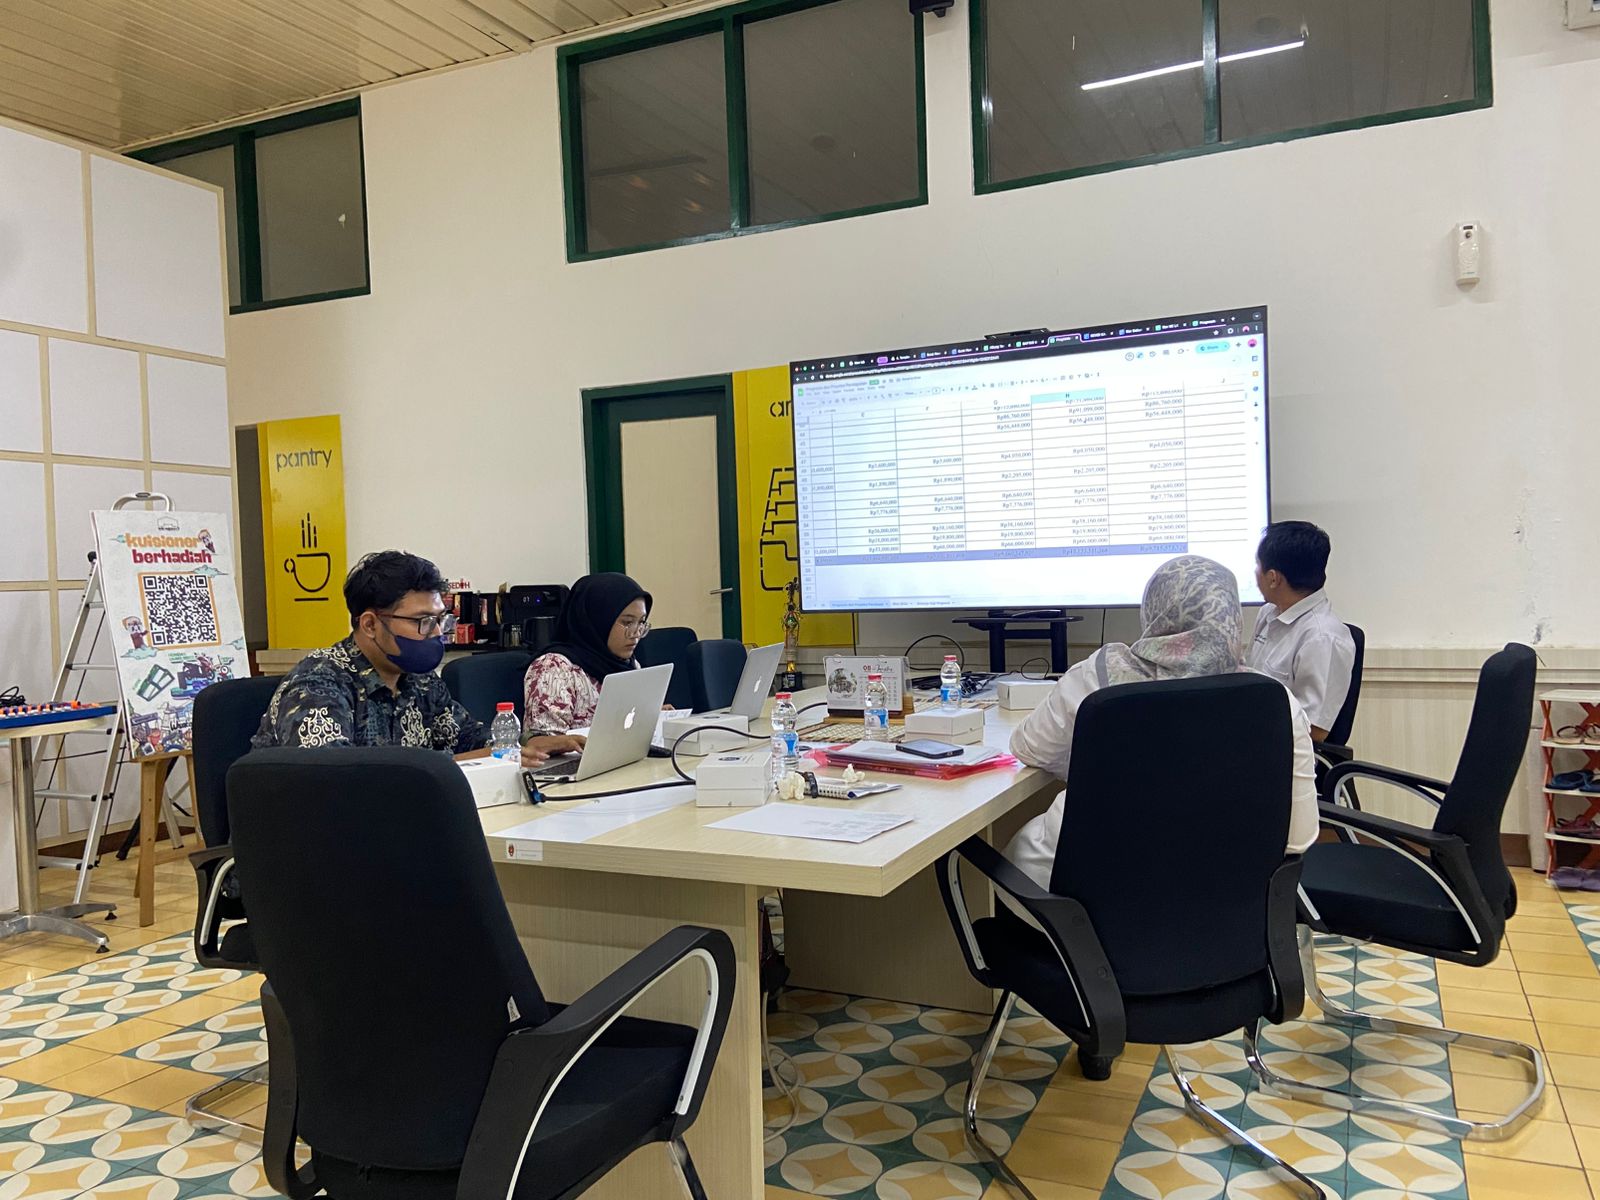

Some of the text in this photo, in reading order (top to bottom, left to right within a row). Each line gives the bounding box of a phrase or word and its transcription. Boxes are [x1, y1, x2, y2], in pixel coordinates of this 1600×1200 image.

[276, 448, 332, 472] pantry
[125, 532, 198, 548] kuisioner
[132, 549, 212, 564] berhadiah
